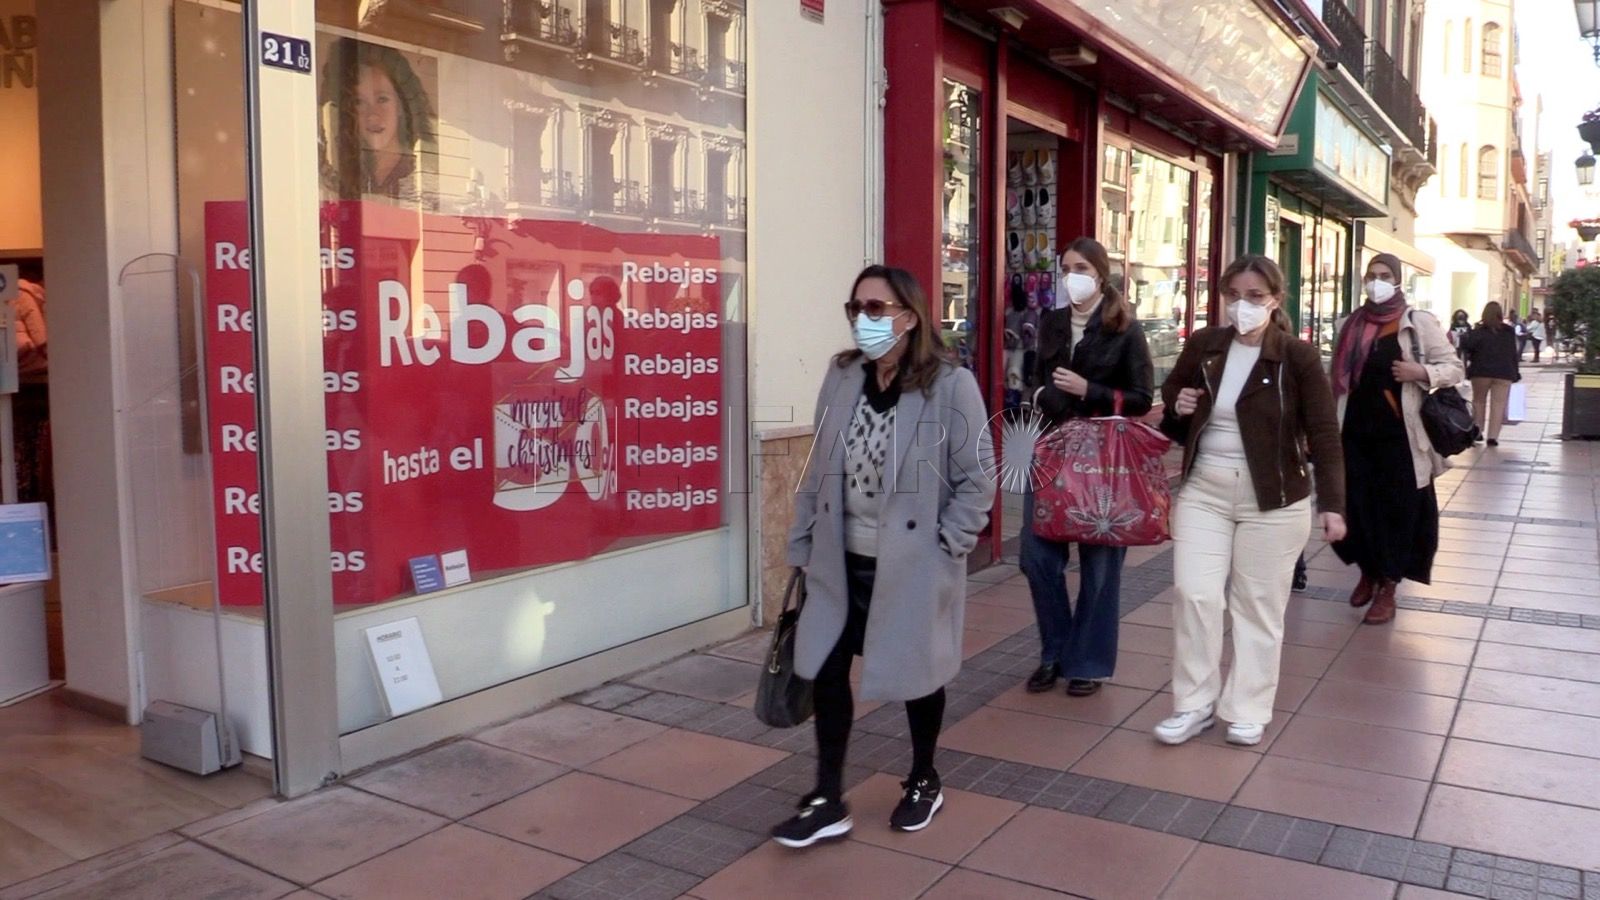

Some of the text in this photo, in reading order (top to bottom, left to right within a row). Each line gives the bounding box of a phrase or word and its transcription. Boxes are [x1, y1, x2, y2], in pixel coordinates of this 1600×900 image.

[263, 38, 293, 65] 21
[622, 260, 718, 289] Rebajas
[378, 278, 615, 384] Rebajas
[623, 306, 718, 334] Rebajas
[624, 352, 719, 380] Rebajas
[624, 394, 718, 422] Rebajas
[383, 446, 440, 485] hasta
[449, 437, 484, 471] el
[625, 440, 718, 469] Rebajas
[626, 484, 718, 512] Rebajas
